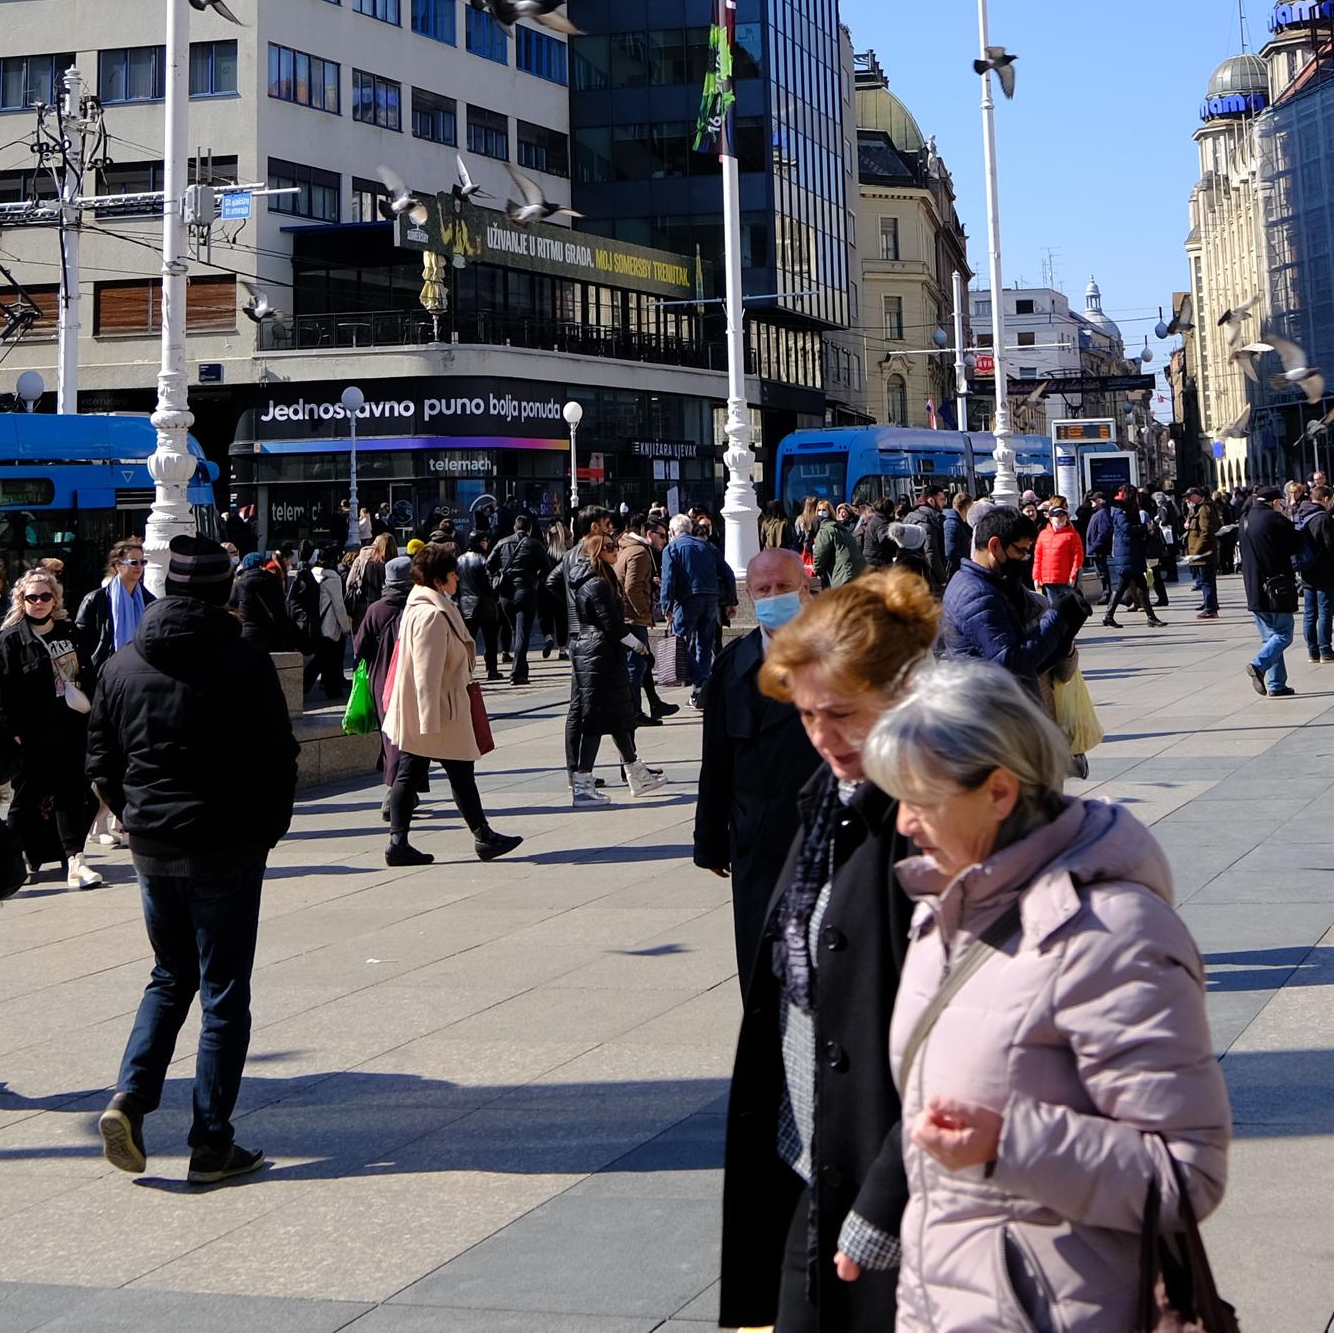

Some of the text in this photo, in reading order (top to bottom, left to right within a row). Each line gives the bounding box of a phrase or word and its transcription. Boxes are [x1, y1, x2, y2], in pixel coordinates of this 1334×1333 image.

[487, 222, 690, 287] UŽIVANJE U RITMU GRADA. MOJ SOMERSBY TRENUTAK.
[260, 393, 561, 423] Jednosavno puno bolja ponuda
[640, 438, 697, 459] KNJIŽARA LJEVAK
[428, 457, 492, 471] telemach
[271, 501, 323, 522] telemc
